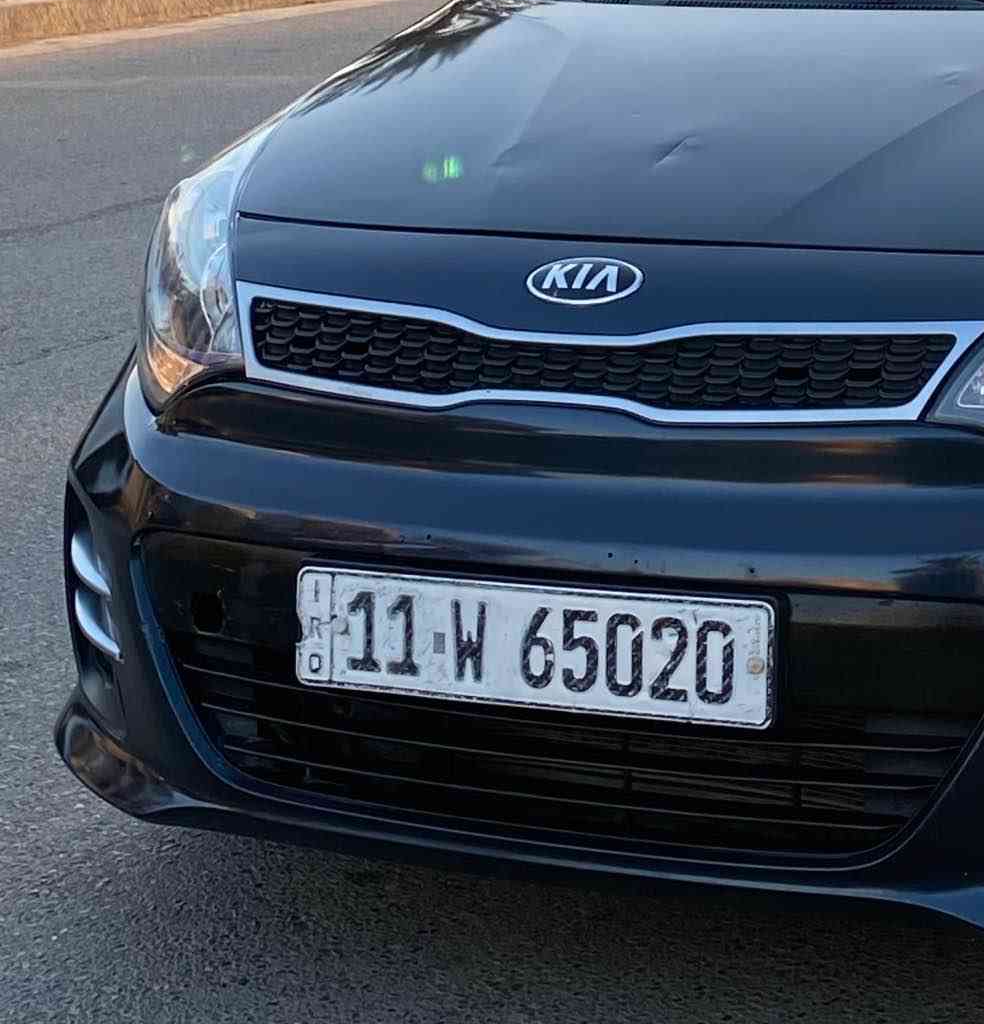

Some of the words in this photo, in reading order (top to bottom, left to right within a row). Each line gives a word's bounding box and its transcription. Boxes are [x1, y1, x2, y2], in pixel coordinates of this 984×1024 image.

[542, 263, 619, 293] KIA
[346, 591, 421, 678] 11
[451, 598, 488, 683] W
[520, 605, 735, 706] 65020
